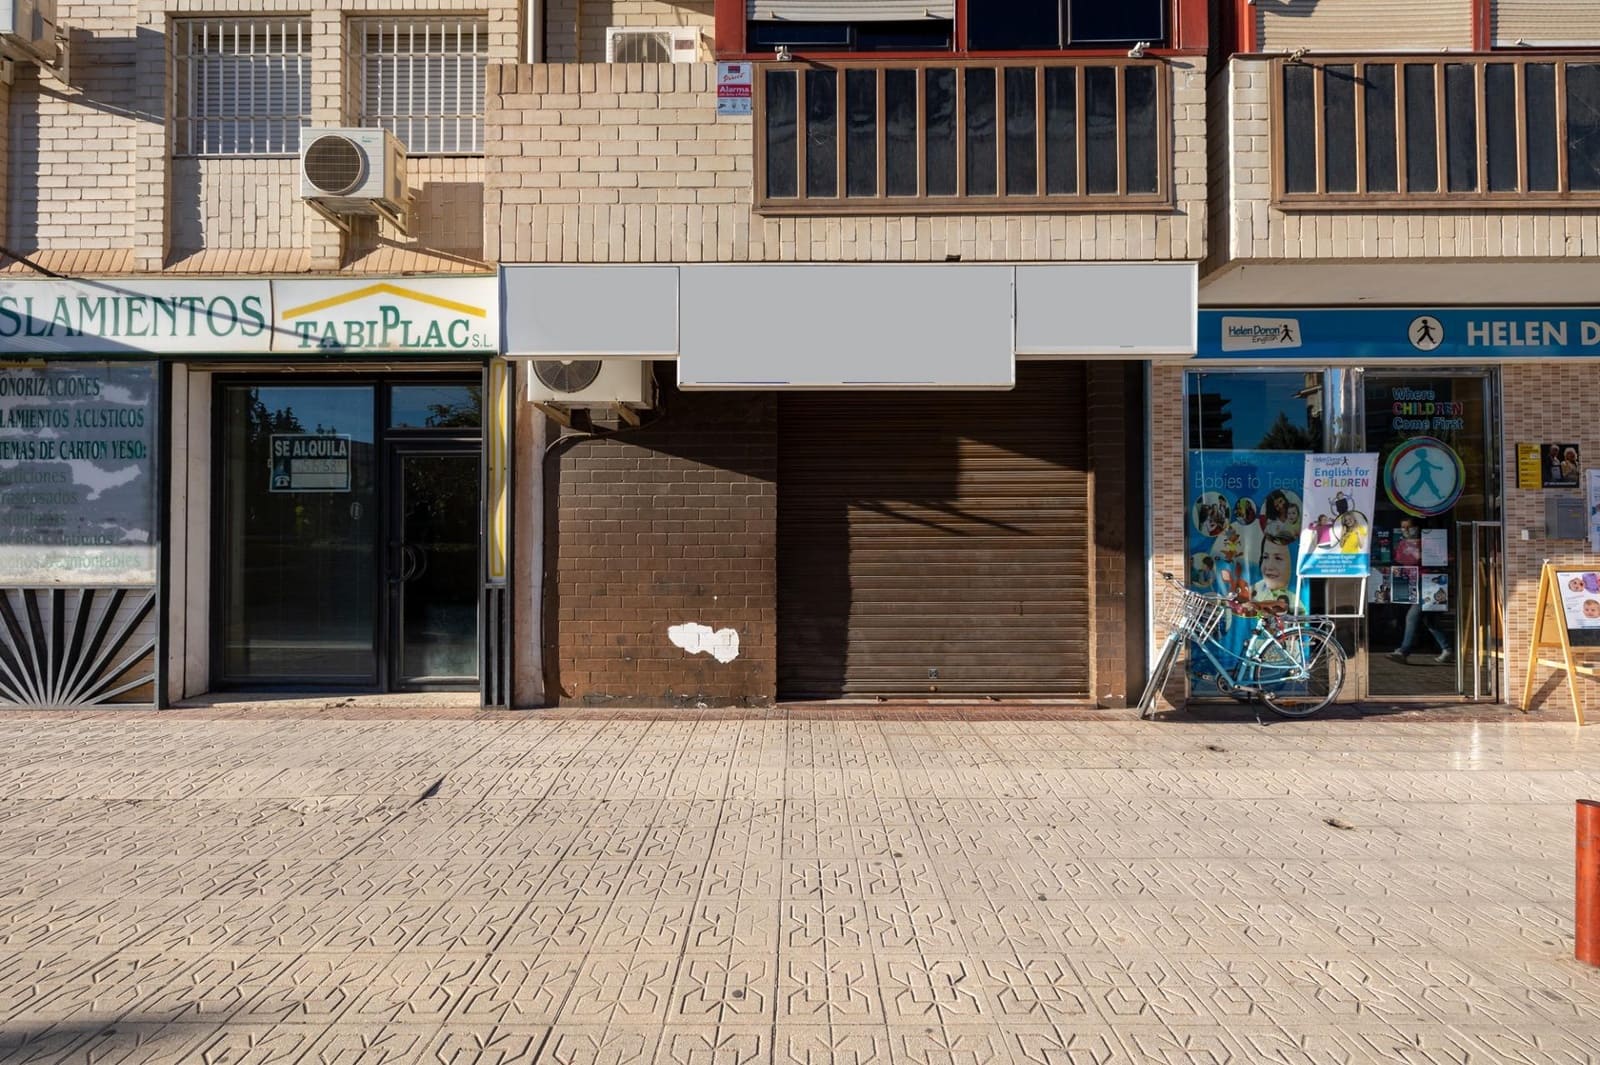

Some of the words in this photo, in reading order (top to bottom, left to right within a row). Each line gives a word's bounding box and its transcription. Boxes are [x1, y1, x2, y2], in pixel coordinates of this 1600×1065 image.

[720, 85, 750, 93] Alarma
[0, 295, 266, 337] SLAMIENTOS
[1229, 325, 1253, 335] Helen
[1467, 321, 1567, 346] HELEN
[472, 333, 493, 348] S.L.
[1392, 387, 1435, 400] Where
[1392, 402, 1464, 416] CHILDREN
[73, 408, 145, 428] ACUSTICOS
[1392, 417, 1430, 430] Come
[1433, 417, 1464, 430] First
[39, 440, 55, 460] DE
[59, 440, 107, 460] CARTON
[112, 440, 147, 459] YESO:
[274, 440, 290, 456] SE
[292, 440, 347, 457] ALQUILA
[1314, 467, 1352, 479] English
[1355, 467, 1369, 477] for
[1194, 472, 1242, 489] Babies
[1248, 473, 1261, 489] to
[1313, 478, 1369, 488] CHILDREN
